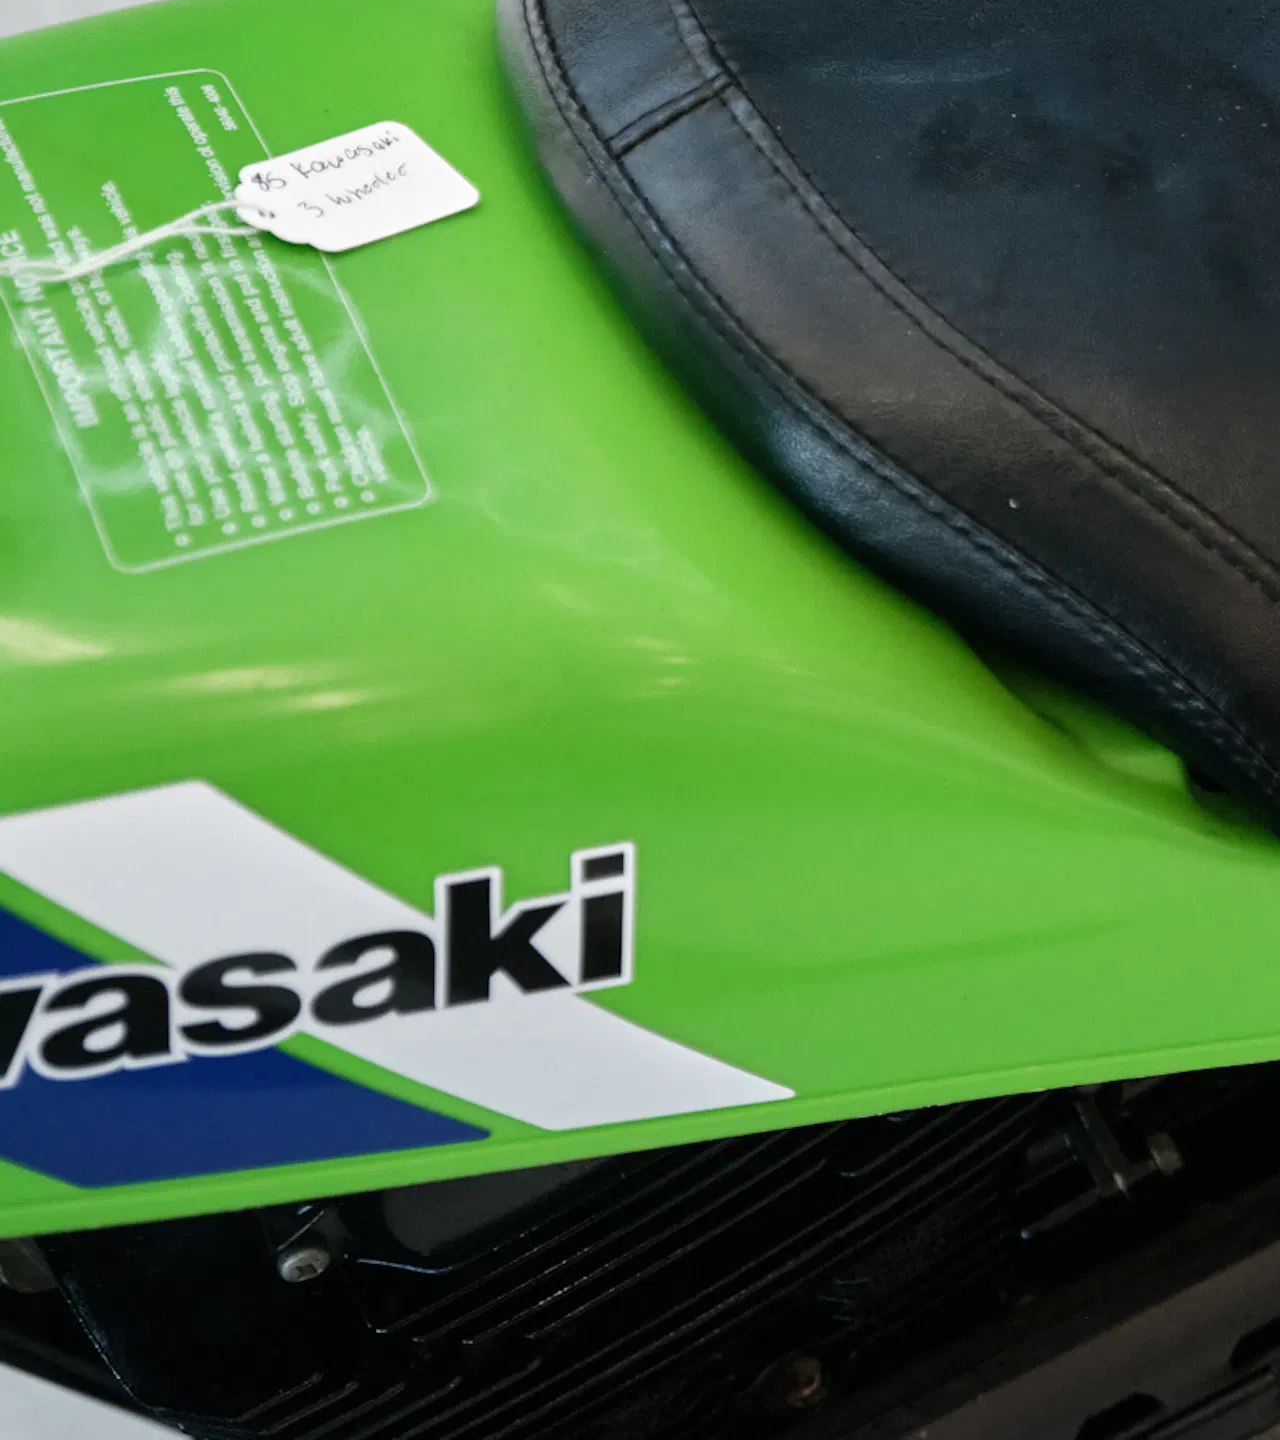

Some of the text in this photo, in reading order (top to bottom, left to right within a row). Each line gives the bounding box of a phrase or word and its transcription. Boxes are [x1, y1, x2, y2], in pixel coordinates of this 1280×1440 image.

[161, 86, 186, 106] this
[174, 105, 211, 145] operate
[24, 192, 47, 213] not
[233, 272, 259, 296] put
[243, 296, 269, 323] and
[26, 305, 100, 428] IMPORTANT
